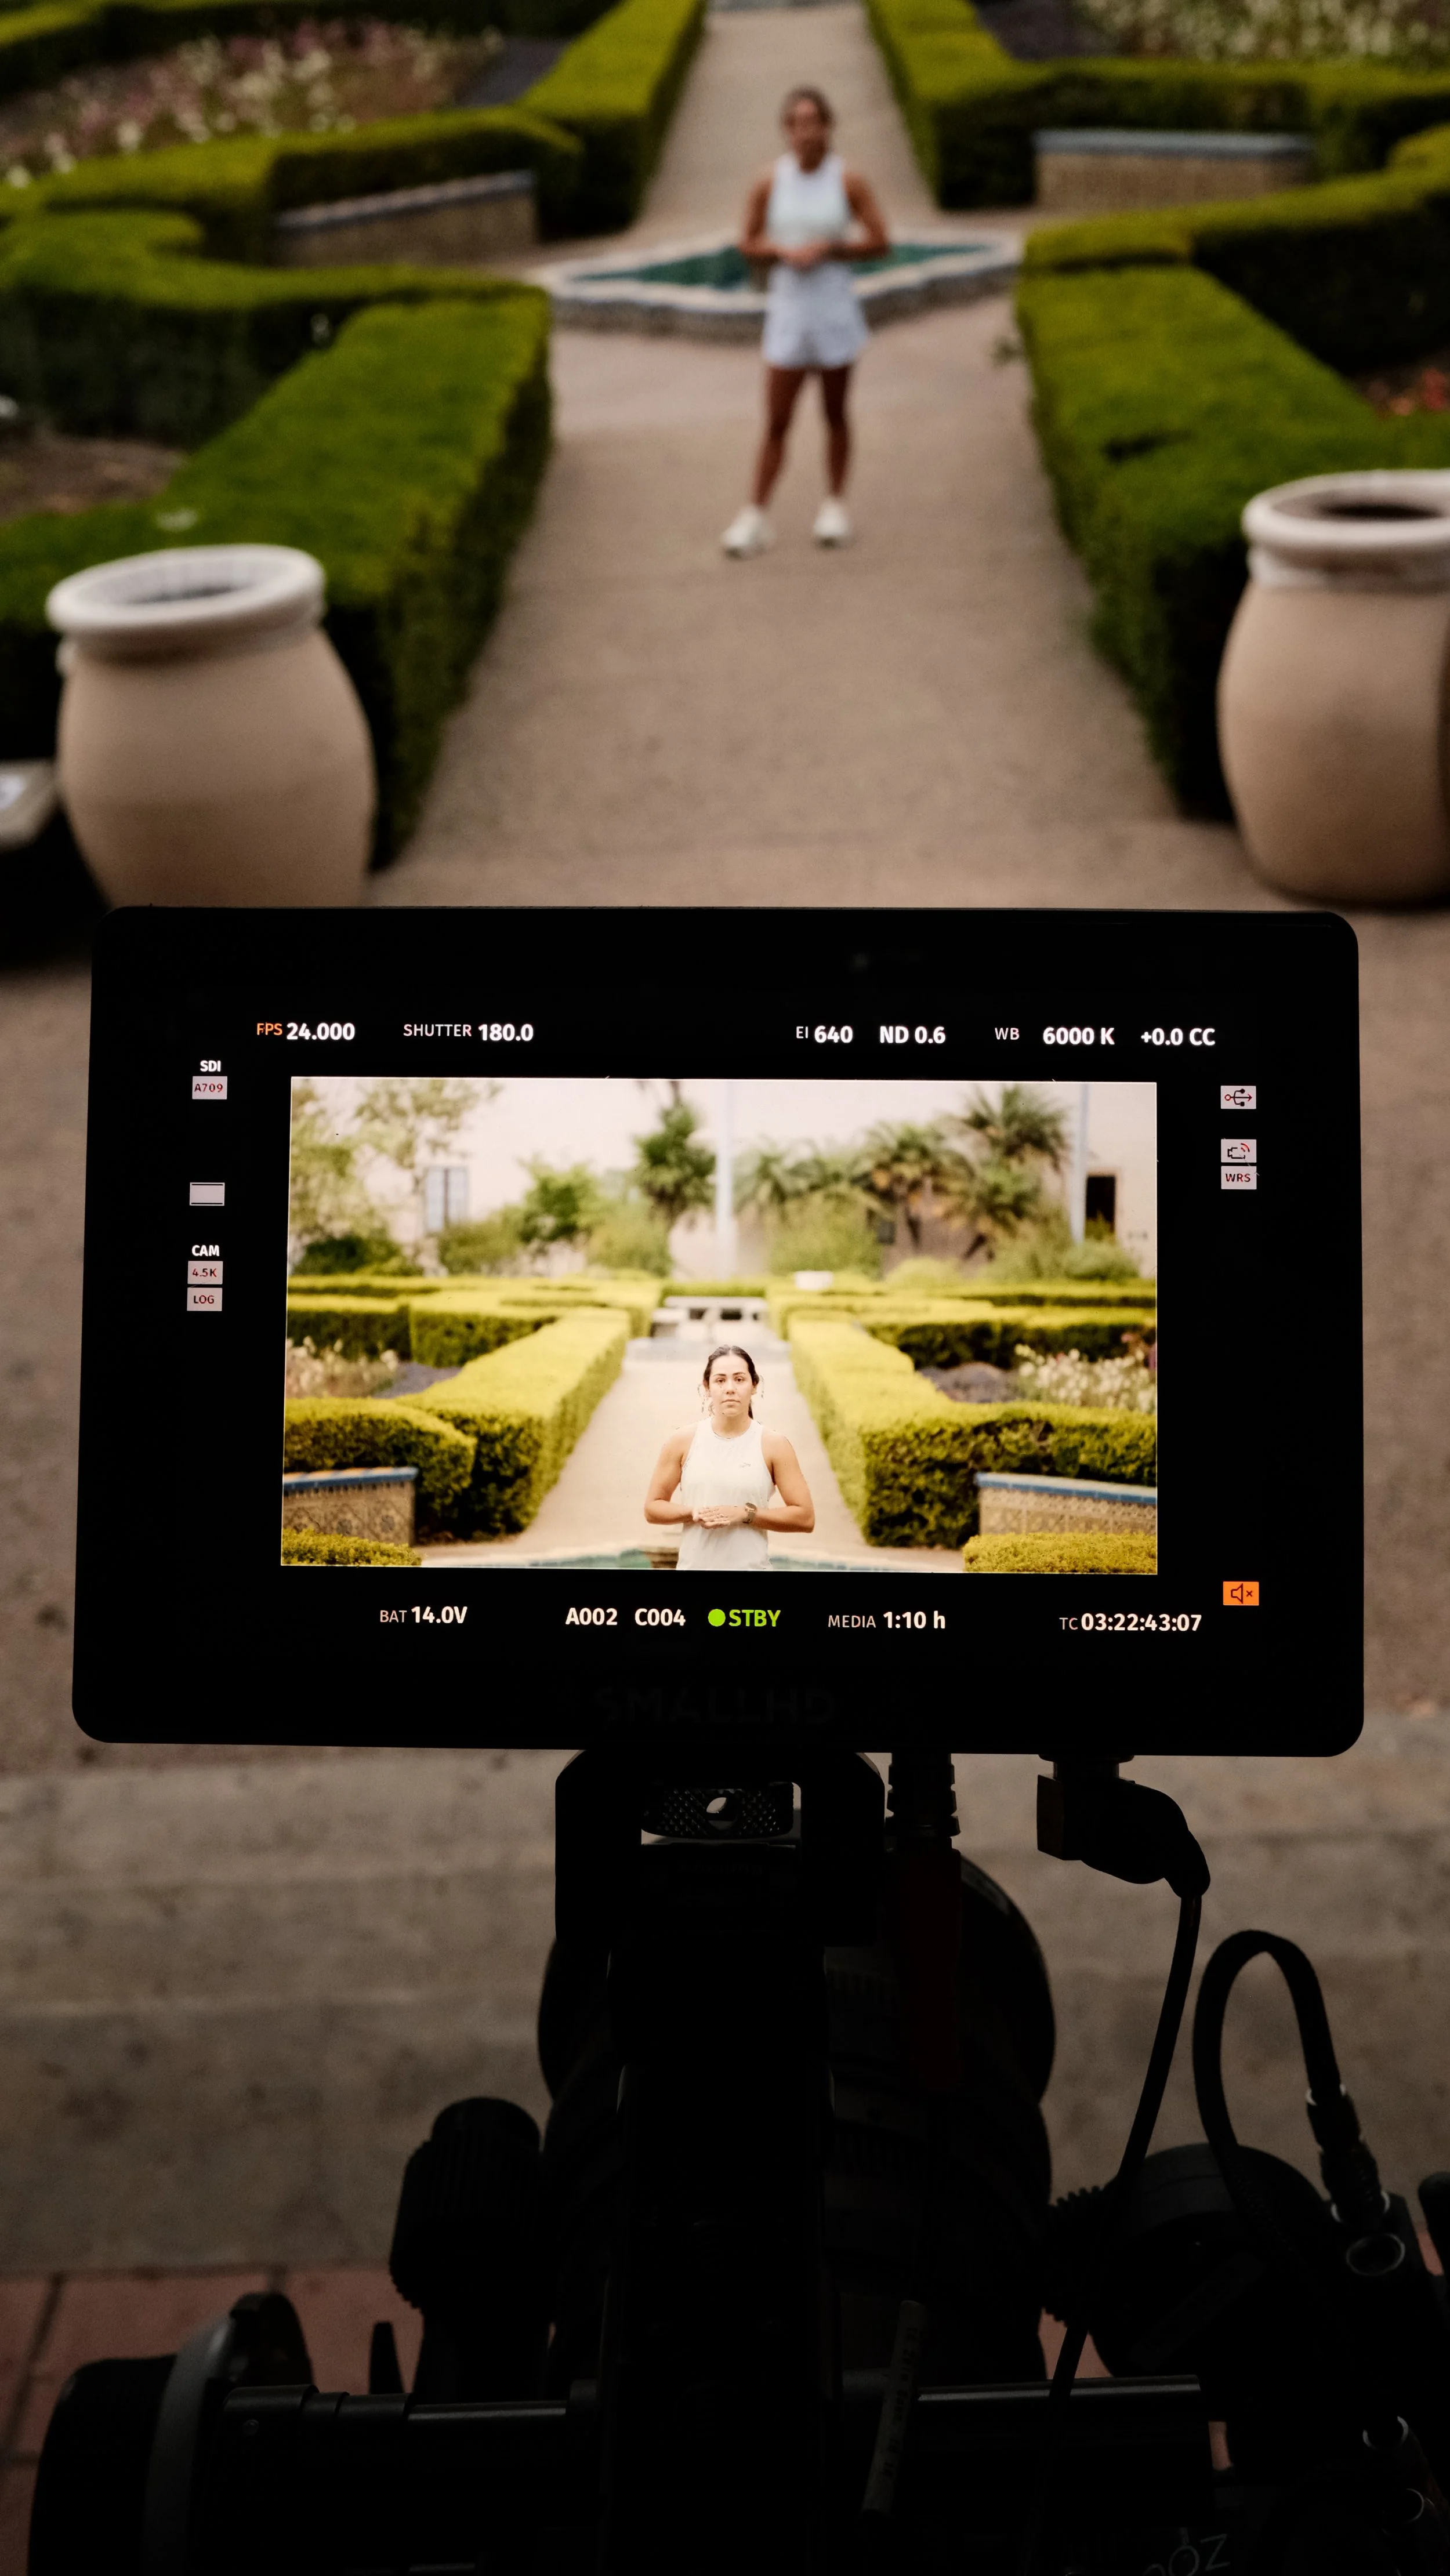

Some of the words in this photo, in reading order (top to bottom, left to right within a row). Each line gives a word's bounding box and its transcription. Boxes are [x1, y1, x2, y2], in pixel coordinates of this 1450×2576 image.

[256, 1022, 283, 1036] FPS
[286, 1022, 356, 1041] 24.000
[403, 1024, 472, 1037] SHUTTER
[478, 1023, 534, 1042] 180.0
[796, 1026, 809, 1039] EI
[814, 1025, 853, 1043] 640
[879, 1025, 909, 1044] ND
[914, 1025, 946, 1044] 0.6
[994, 1027, 1020, 1040] WB
[1042, 1026, 1095, 1045] 6000
[1100, 1027, 1115, 1045] K
[1140, 1027, 1184, 1046] +0.0
[1189, 1027, 1216, 1046] CC
[200, 1060, 222, 1072] SDI
[194, 1083, 223, 1093] A709
[1225, 1173, 1251, 1182] WRS
[191, 1245, 220, 1257] CAM
[192, 1268, 217, 1278] 4.5K
[193, 1294, 215, 1304] LOG
[380, 1610, 407, 1623] BAT
[411, 1606, 468, 1624] 14.0V
[565, 1607, 618, 1626] A002
[635, 1608, 686, 1627] C004
[728, 1609, 781, 1627] STBY
[828, 1614, 876, 1628] MEDIA
[883, 1611, 927, 1629] 1:10
[933, 1610, 946, 1629] h
[1058, 1617, 1078, 1630] TC
[1081, 1613, 1202, 1631] 03:22:43:07
[594, 1686, 836, 1725] SMALLHD
